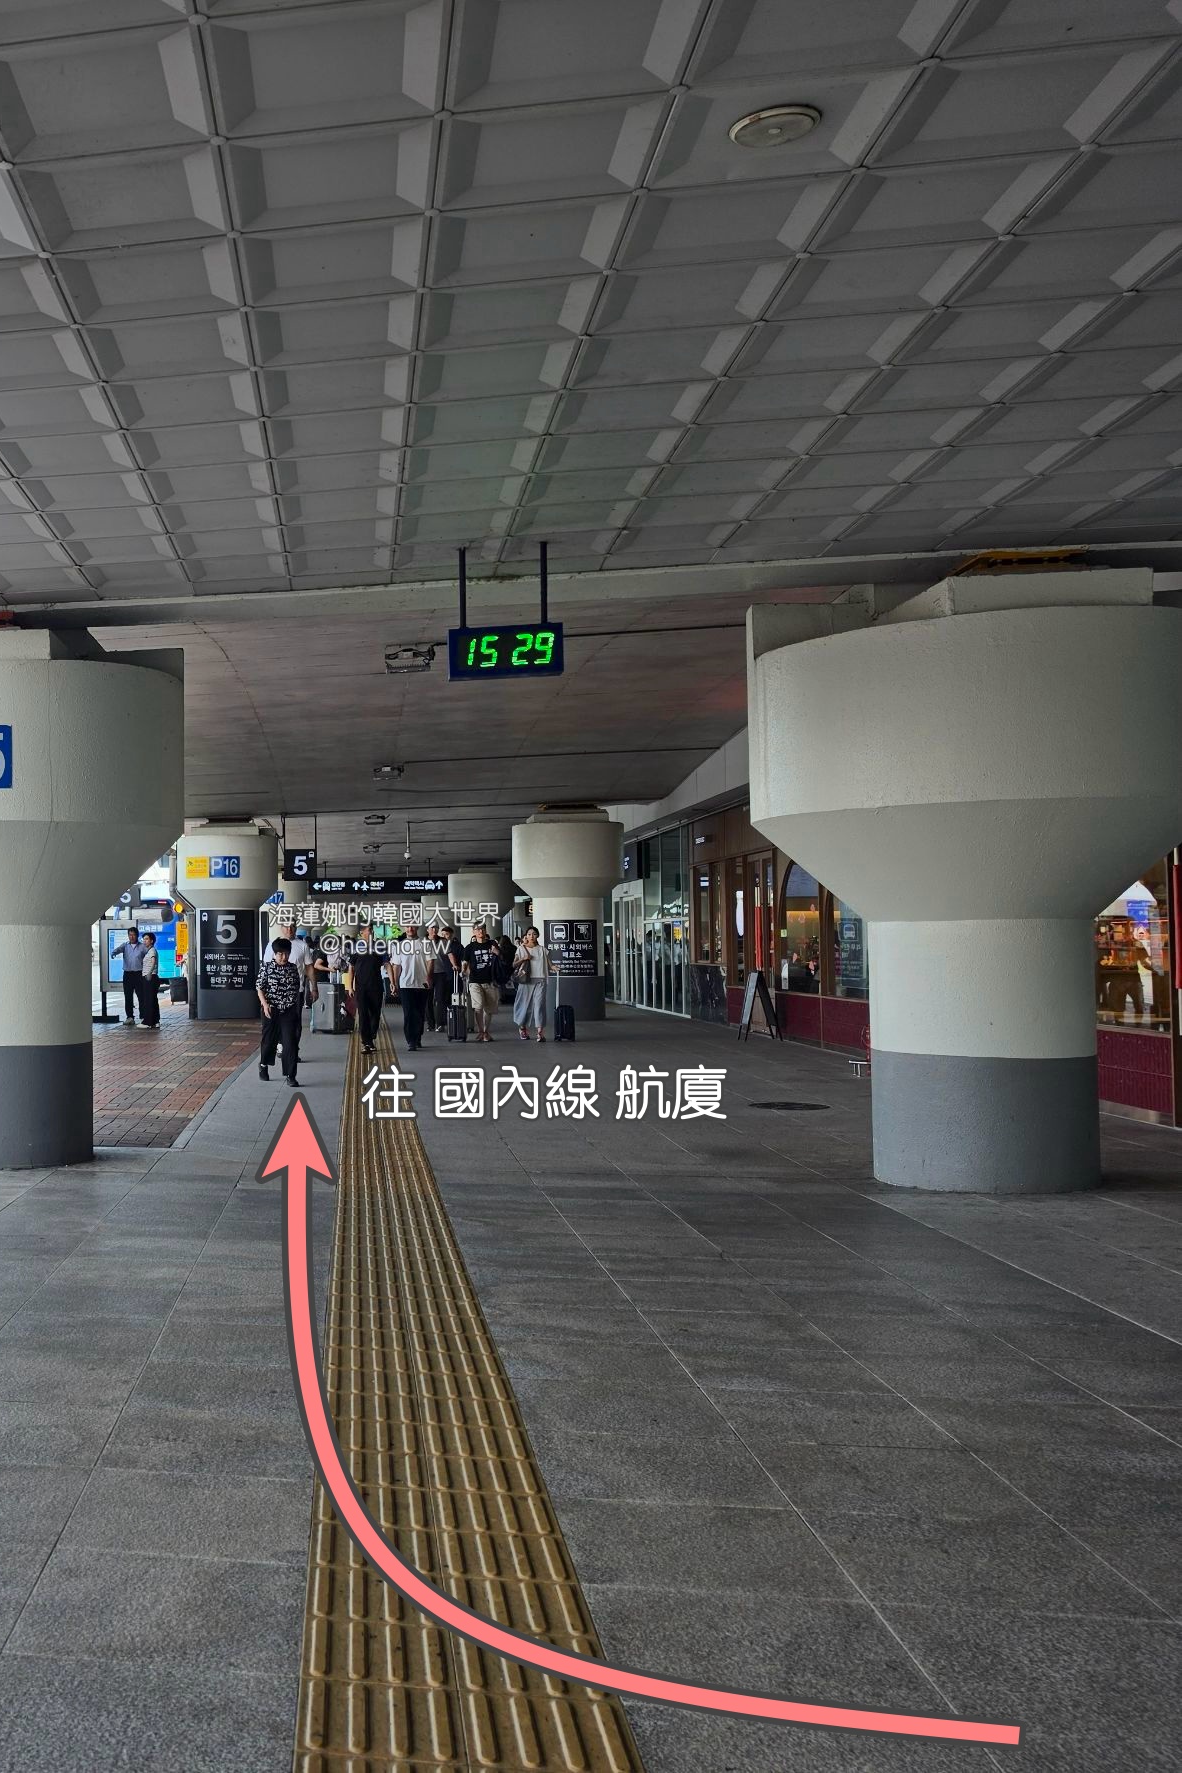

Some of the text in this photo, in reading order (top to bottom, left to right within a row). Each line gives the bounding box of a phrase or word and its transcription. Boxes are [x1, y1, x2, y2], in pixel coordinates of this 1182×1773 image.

[468, 632, 555, 667] 15 29
[210, 858, 238, 876] P16
[293, 855, 308, 875] 5
[215, 914, 238, 944] 5
